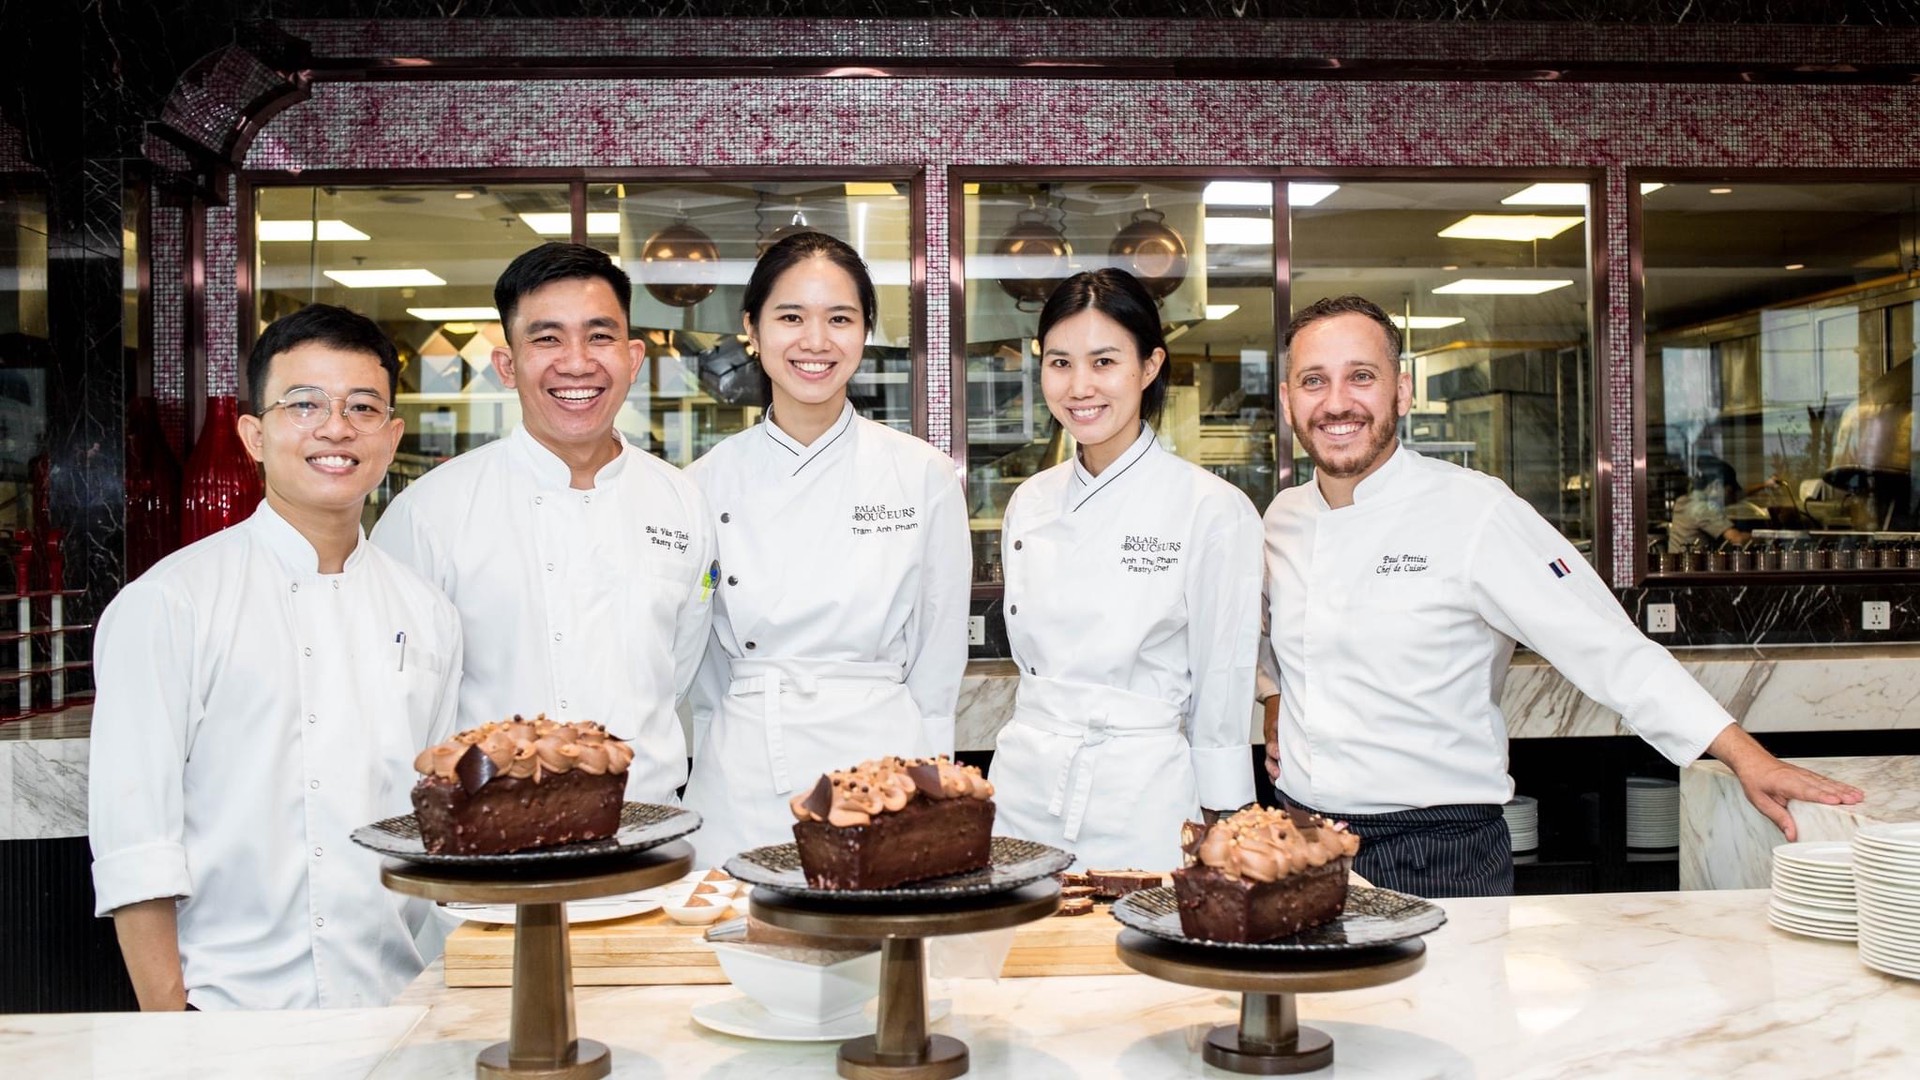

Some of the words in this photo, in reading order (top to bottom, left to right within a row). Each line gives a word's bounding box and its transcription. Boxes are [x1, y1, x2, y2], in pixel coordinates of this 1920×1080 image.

[854, 504, 886, 513] PALAIS
[854, 507, 916, 521] DOUCEURS
[876, 525, 892, 533] Anh
[895, 522, 919, 531] Pham
[651, 536, 671, 550] Pastry
[674, 541, 689, 554] Chef
[1124, 535, 1159, 544] PALAIS
[1123, 541, 1182, 553] DOUCEURS
[1156, 556, 1179, 564] Pham
[1382, 555, 1400, 564] Paul
[1128, 565, 1152, 575] Pastry
[1153, 564, 1170, 572] Chef
[1375, 564, 1392, 576] Chef
[1393, 563, 1401, 572] de
